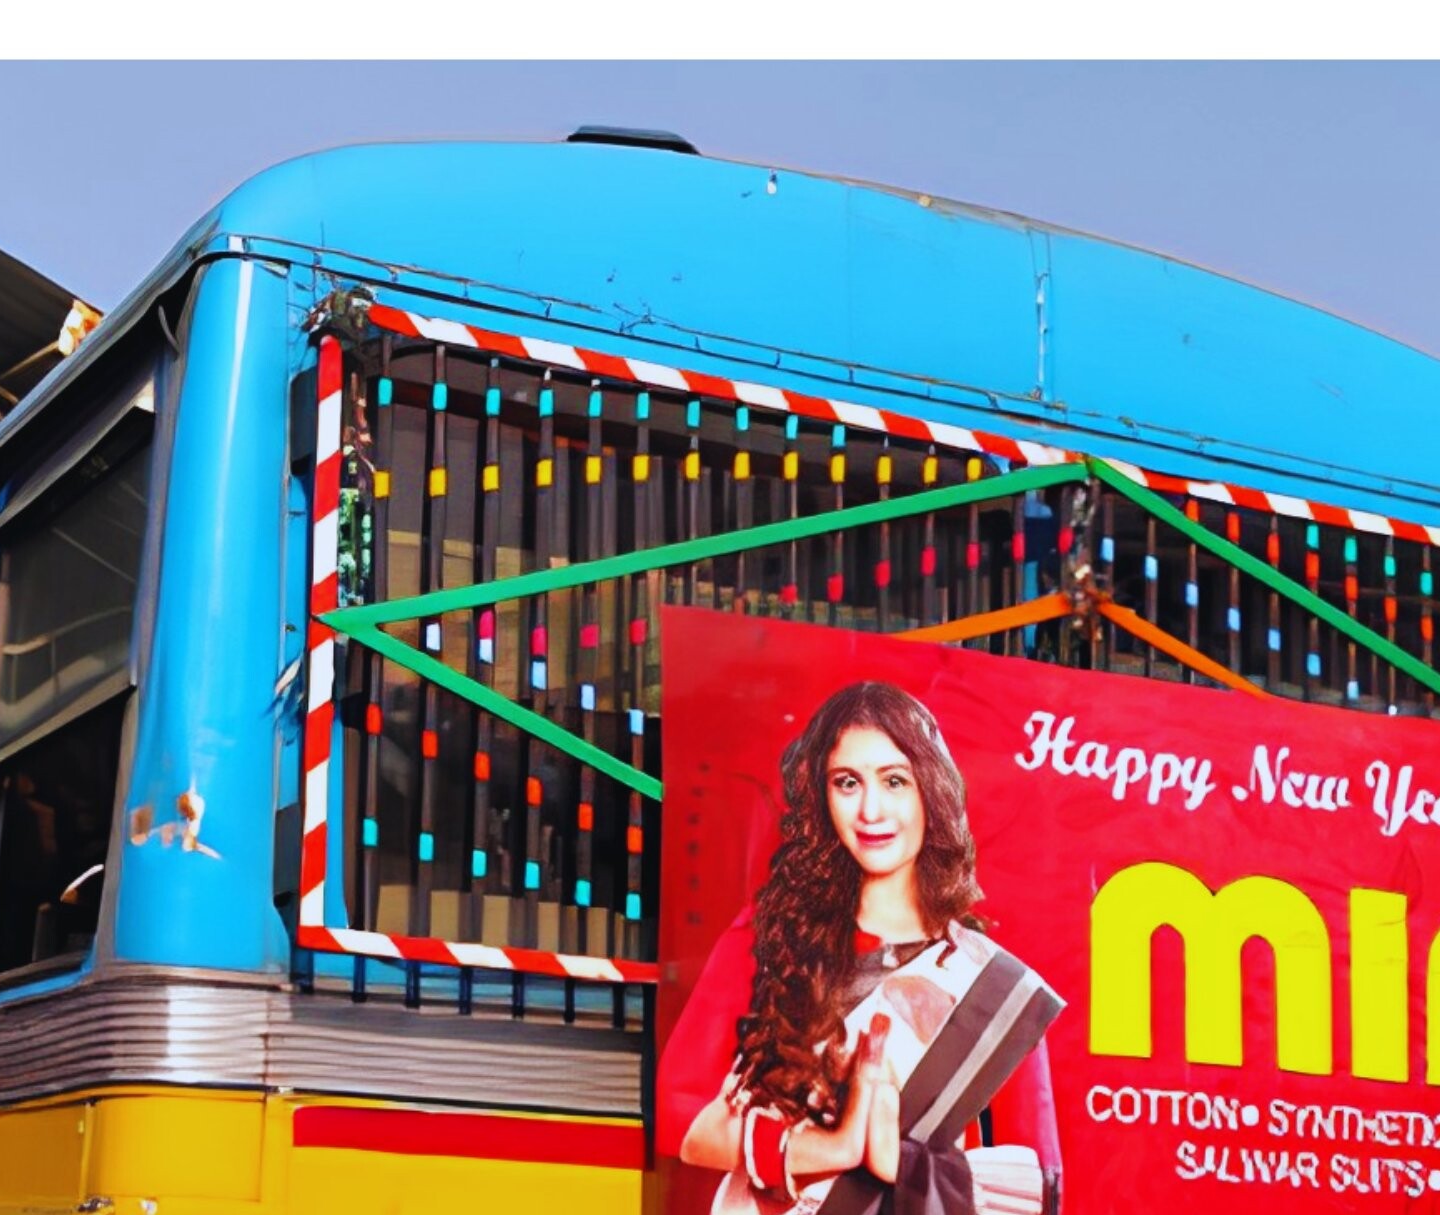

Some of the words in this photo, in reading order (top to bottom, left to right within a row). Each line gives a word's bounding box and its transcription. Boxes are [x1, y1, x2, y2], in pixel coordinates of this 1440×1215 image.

[1014, 710, 1217, 811] Happy
[1231, 744, 1351, 812] New
[1086, 1085, 1240, 1130] COTTON
[1176, 1141, 1320, 1188] SALWAR
